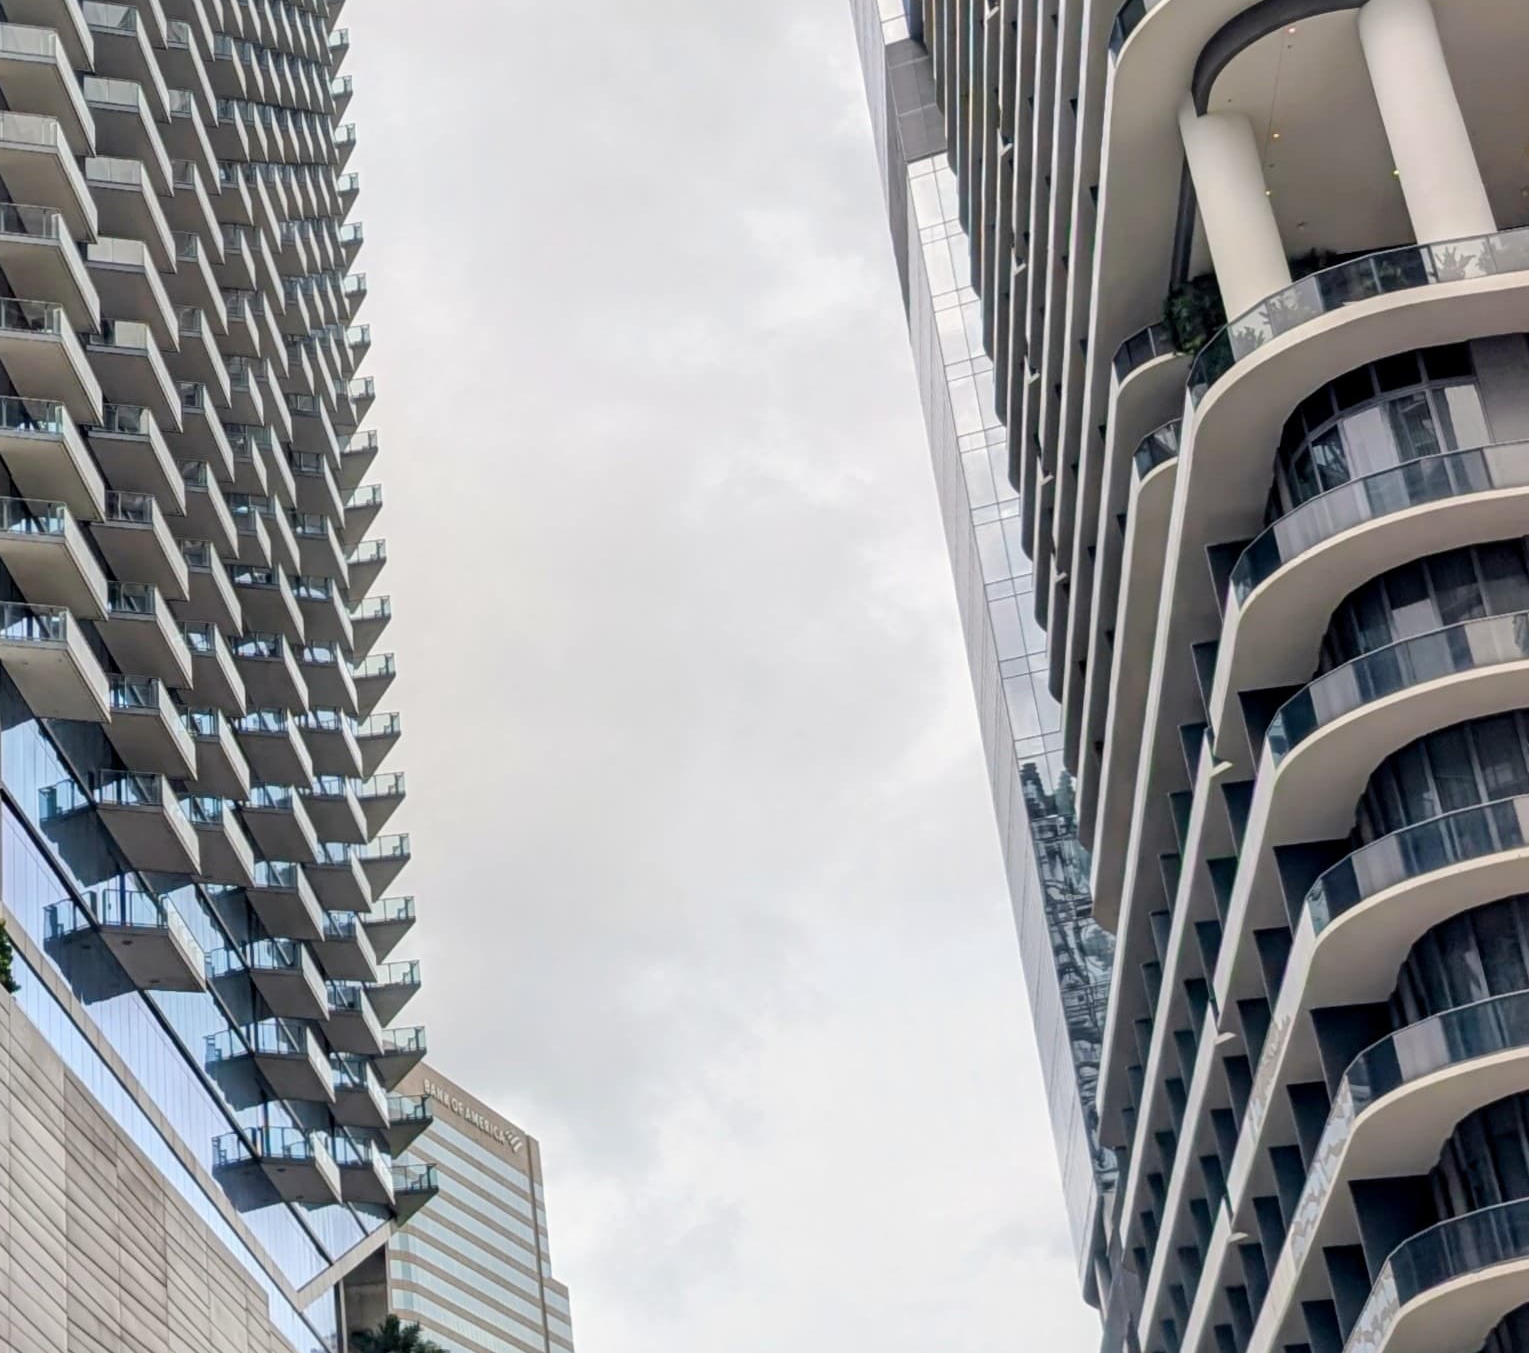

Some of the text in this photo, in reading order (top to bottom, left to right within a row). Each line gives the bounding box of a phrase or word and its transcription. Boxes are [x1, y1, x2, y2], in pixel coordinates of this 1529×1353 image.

[424, 1078, 506, 1146] BANK OF AMERICA
